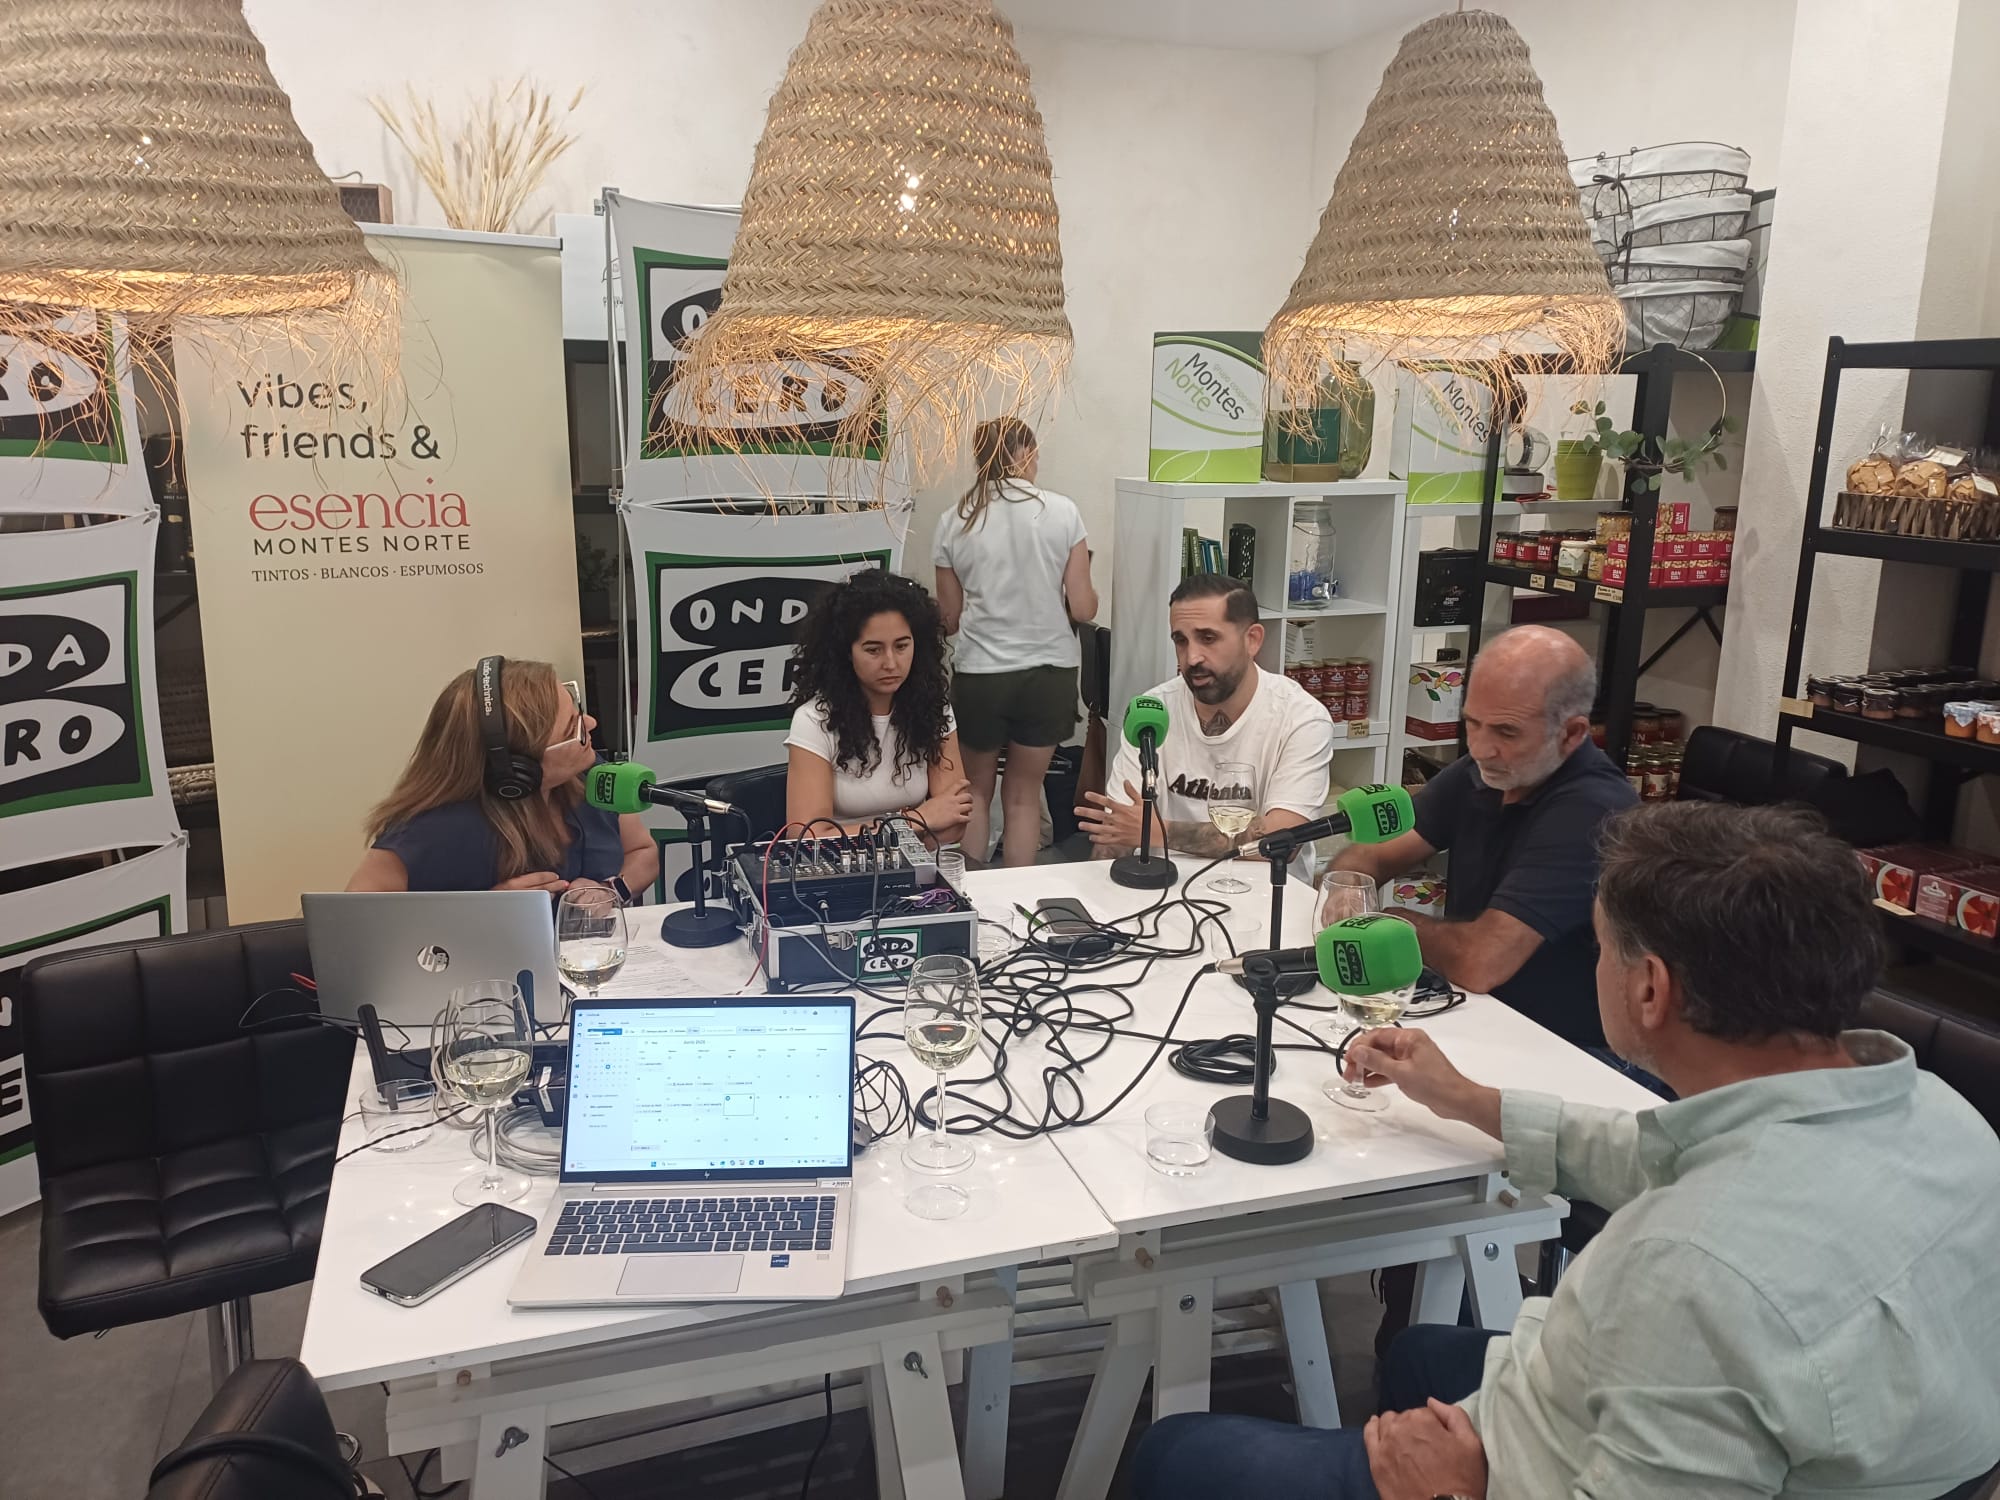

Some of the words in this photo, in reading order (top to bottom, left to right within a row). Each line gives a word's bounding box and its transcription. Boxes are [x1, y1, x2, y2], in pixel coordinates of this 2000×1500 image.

[237, 373, 367, 413] vibes,
[1164, 357, 1211, 411] Norte
[1184, 352, 1245, 421] Montes
[1442, 380, 1490, 443] Montes
[240, 424, 396, 459] friends
[410, 424, 441, 460] &
[249, 477, 470, 531] esencia
[254, 536, 369, 556] MONTES
[383, 534, 471, 552] NORTE
[252, 568, 309, 582] TINTOS
[321, 565, 389, 579] BLANCOS
[400, 563, 484, 577] ESPUMOSOS
[690, 598, 808, 630] OND
[698, 659, 801, 697] CER
[4, 715, 92, 766] RO
[1168, 773, 1252, 801] Atlanta
